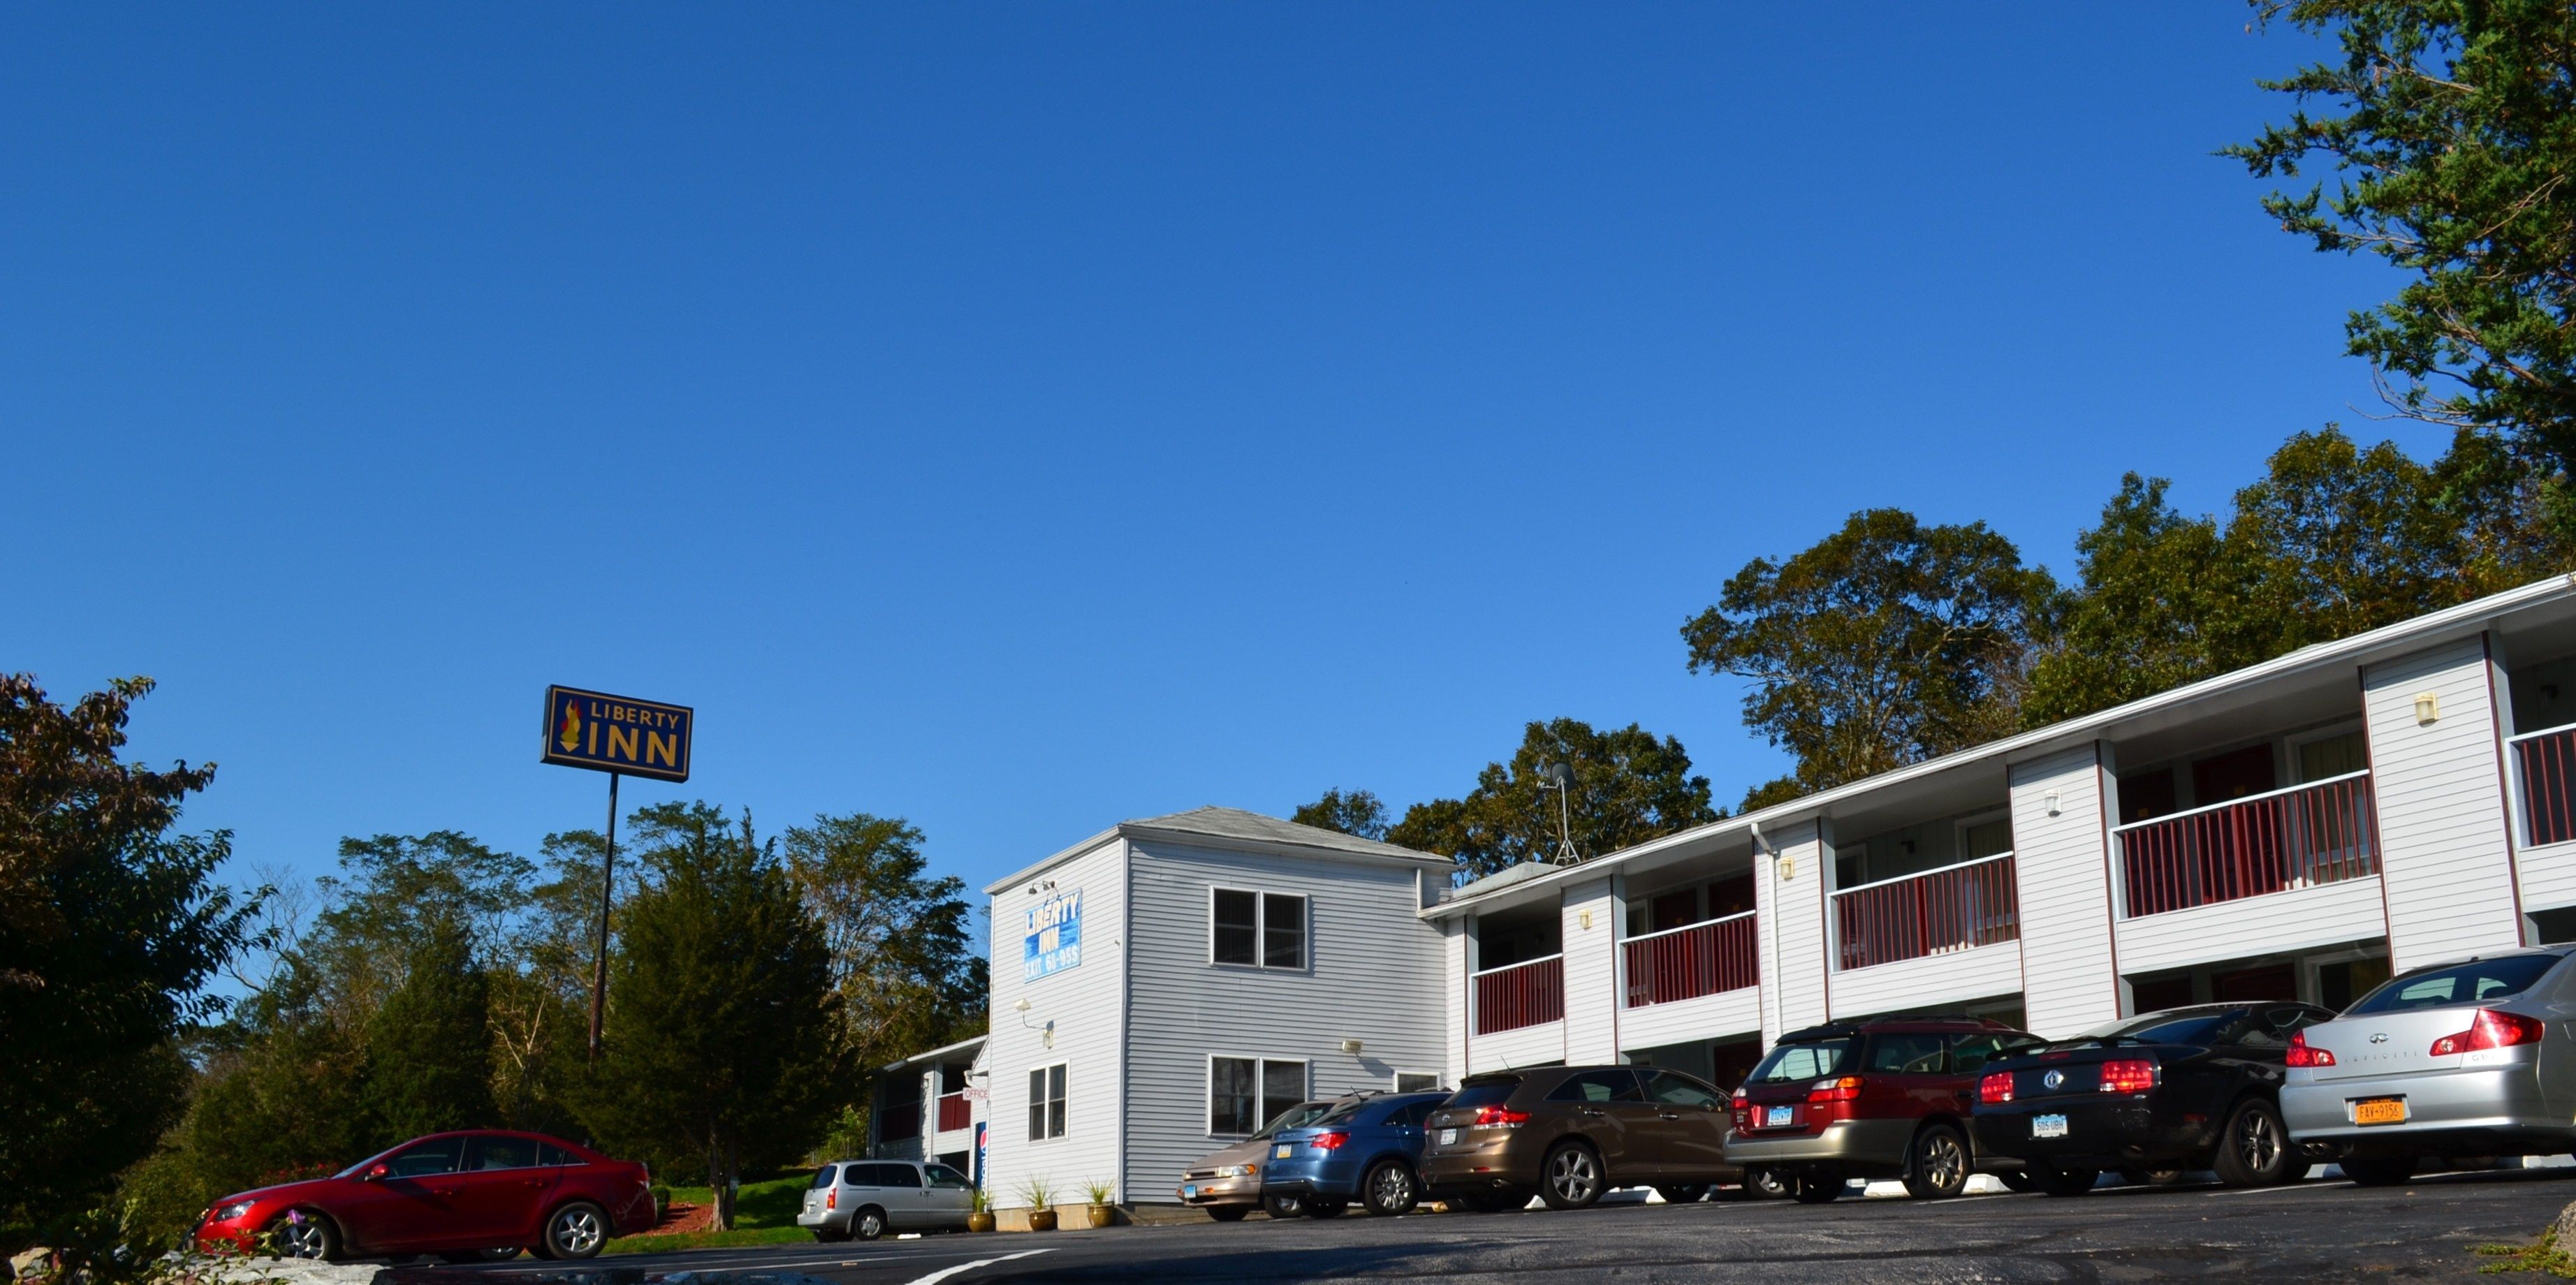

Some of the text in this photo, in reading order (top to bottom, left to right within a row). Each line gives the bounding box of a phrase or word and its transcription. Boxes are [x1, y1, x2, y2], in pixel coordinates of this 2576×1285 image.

[591, 702, 680, 729] LIBERTY
[588, 721, 677, 767] INN
[1026, 893, 1079, 936] LIBERTY
[1039, 925, 1060, 955] INN
[1025, 957, 1041, 978] EXIT
[965, 1089, 988, 1098] OFFICE
